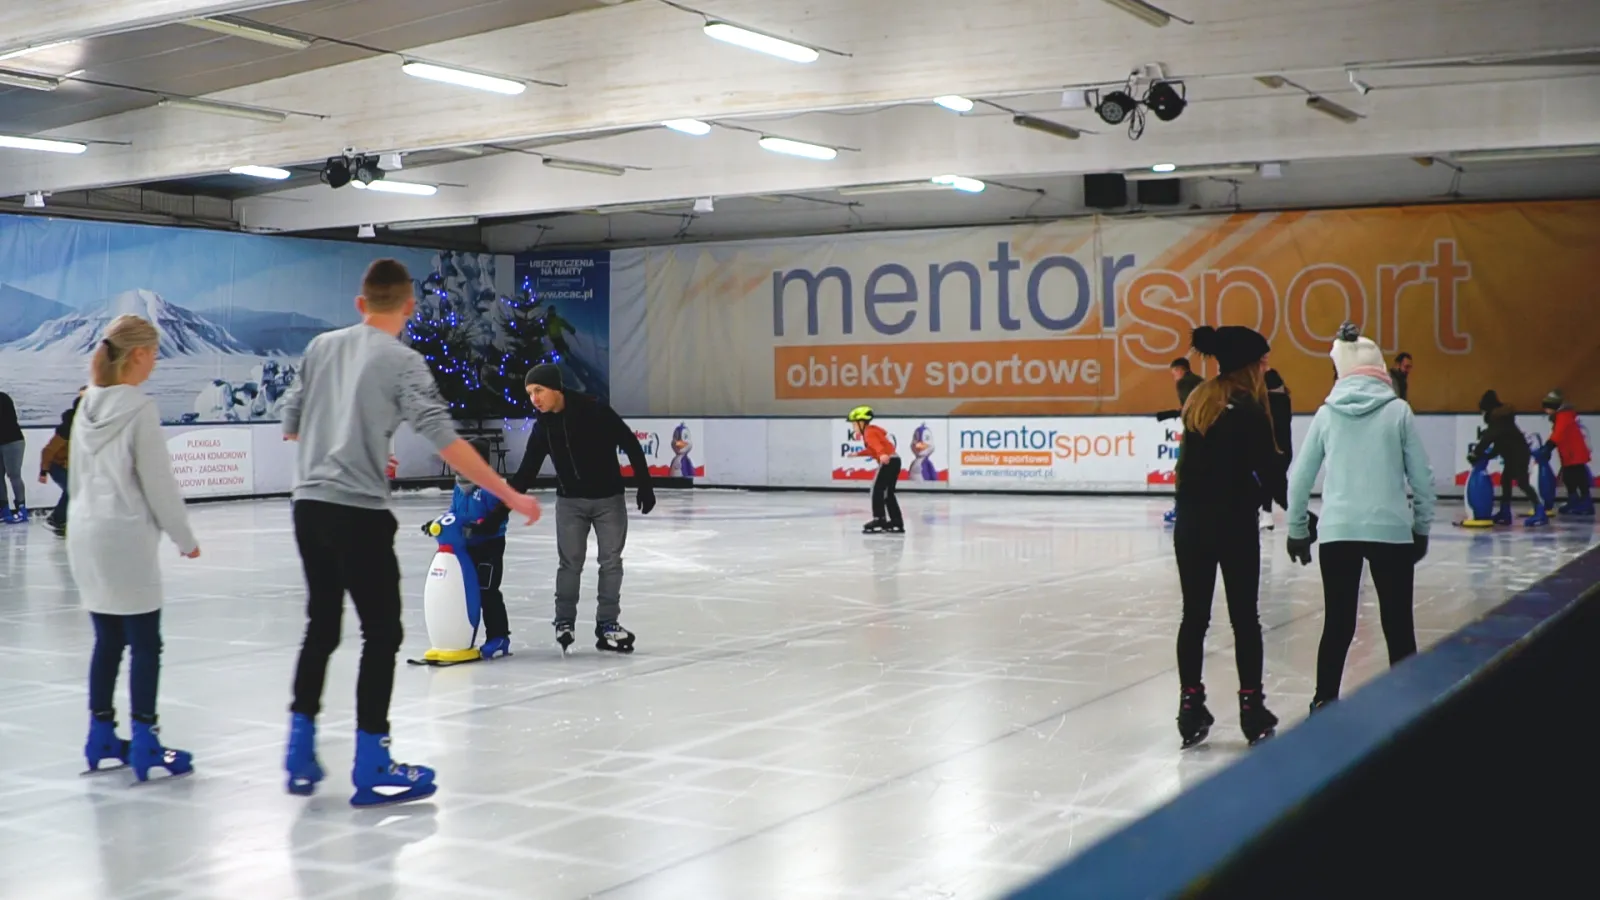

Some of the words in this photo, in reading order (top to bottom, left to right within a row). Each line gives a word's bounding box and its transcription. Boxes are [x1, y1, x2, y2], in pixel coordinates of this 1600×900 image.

[540, 267, 553, 276] NA
[786, 354, 913, 394] obiekty
[925, 352, 1101, 393] sportowe
[187, 439, 221, 448] PLEXIGLAS
